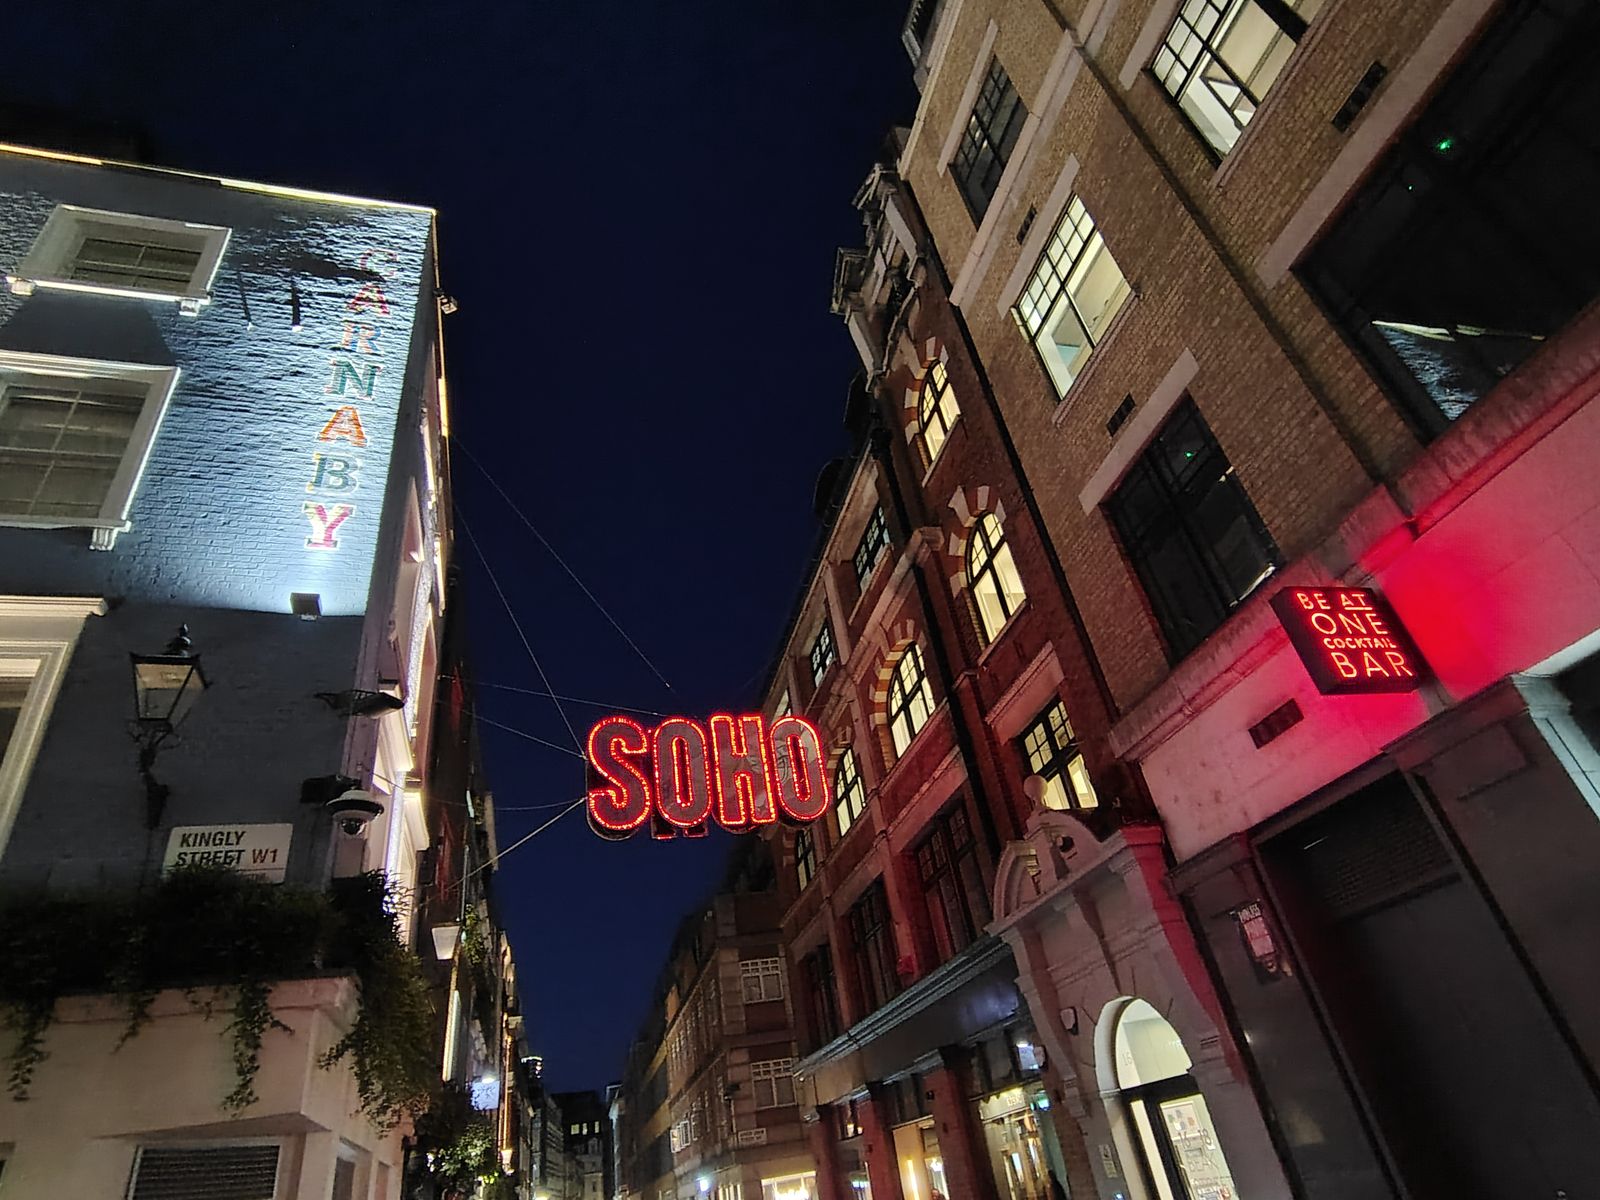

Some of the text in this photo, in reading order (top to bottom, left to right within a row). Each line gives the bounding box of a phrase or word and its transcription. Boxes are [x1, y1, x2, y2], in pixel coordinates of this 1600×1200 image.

[302, 249, 398, 549] CARNABY
[1296, 593, 1370, 610] BE AT
[1311, 612, 1389, 634] ONE
[1323, 637, 1398, 649] COCKTAIL
[1331, 651, 1413, 677] BAR
[587, 714, 830, 830] SOHO
[180, 830, 246, 848] KINGLY
[176, 848, 279, 867] STREET W1
